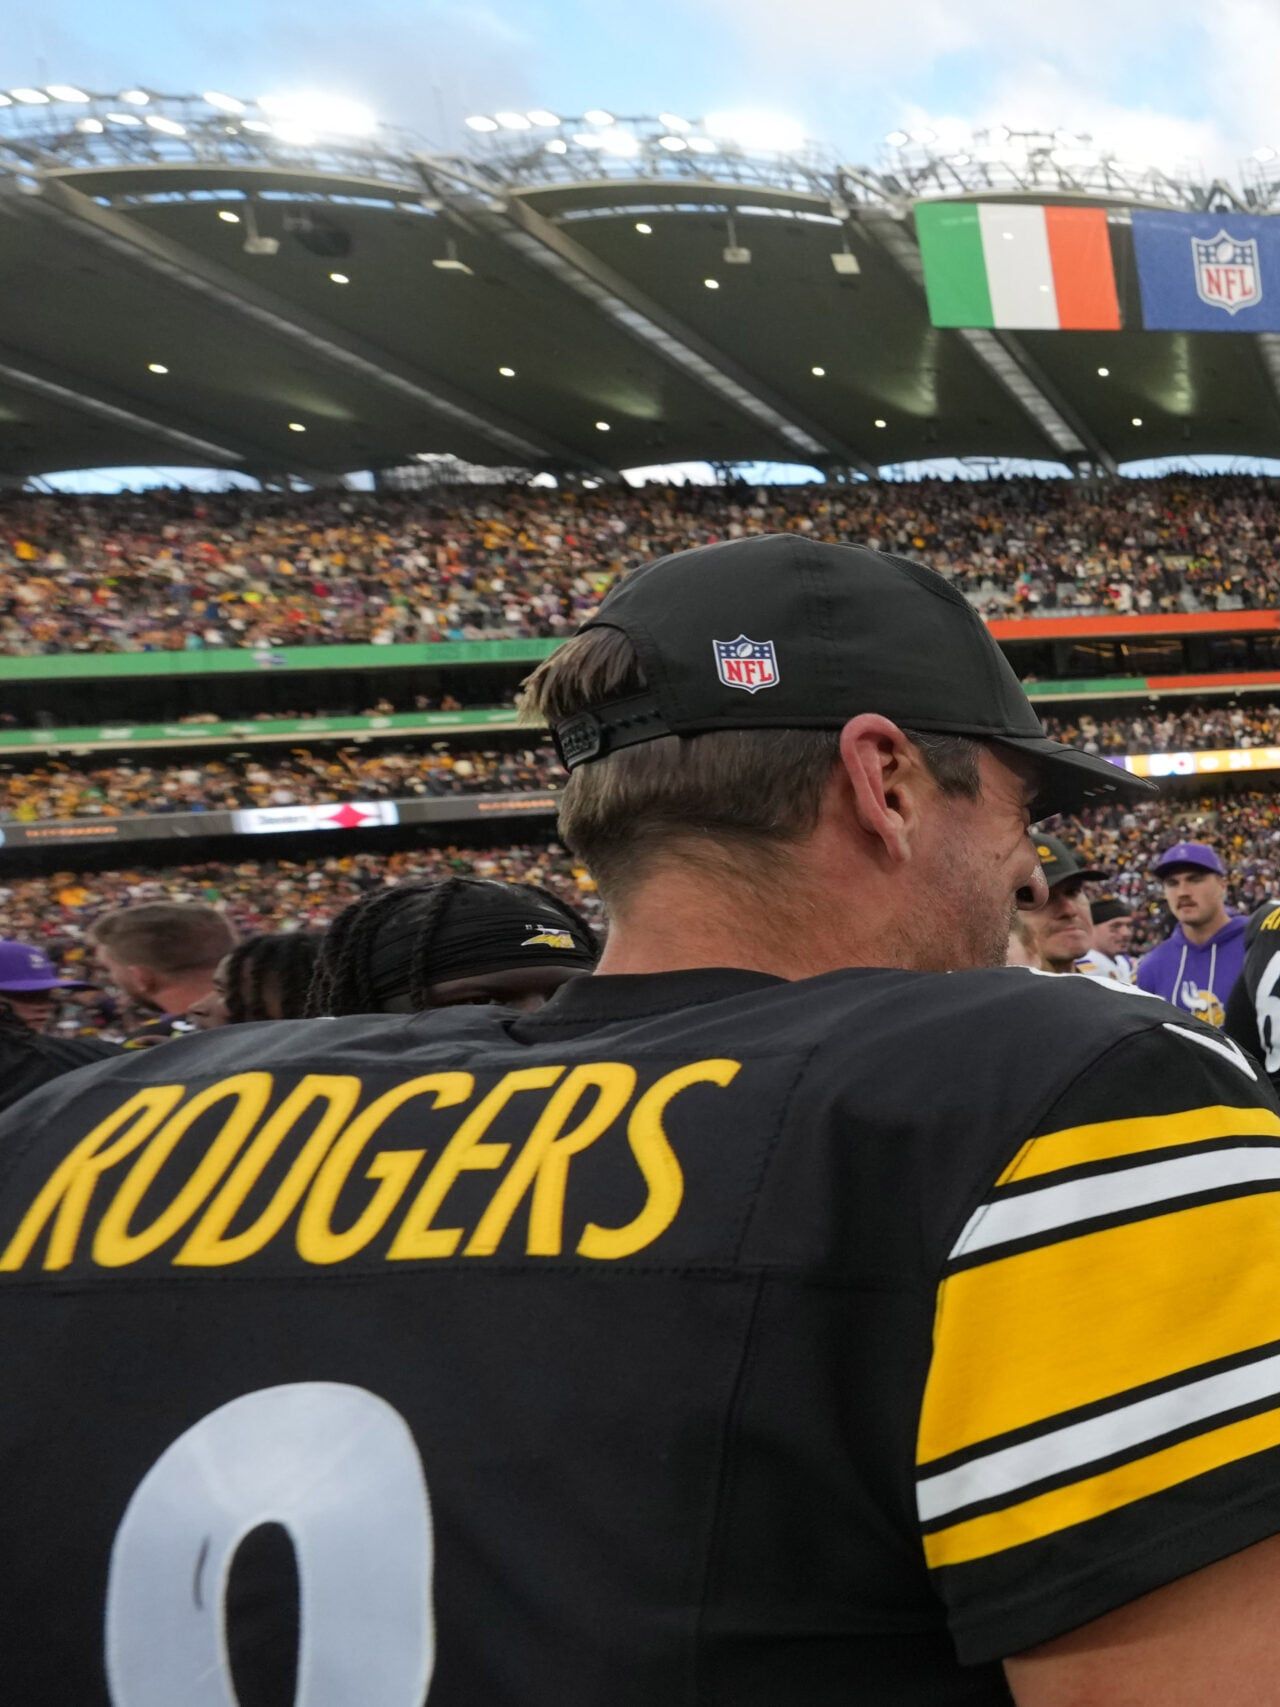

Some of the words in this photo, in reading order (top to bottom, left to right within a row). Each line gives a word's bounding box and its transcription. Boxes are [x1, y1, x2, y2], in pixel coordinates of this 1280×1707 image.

[1204, 267, 1253, 300] NFL
[724, 660, 772, 685] NFL
[0, 1058, 743, 1272] RODGERS
